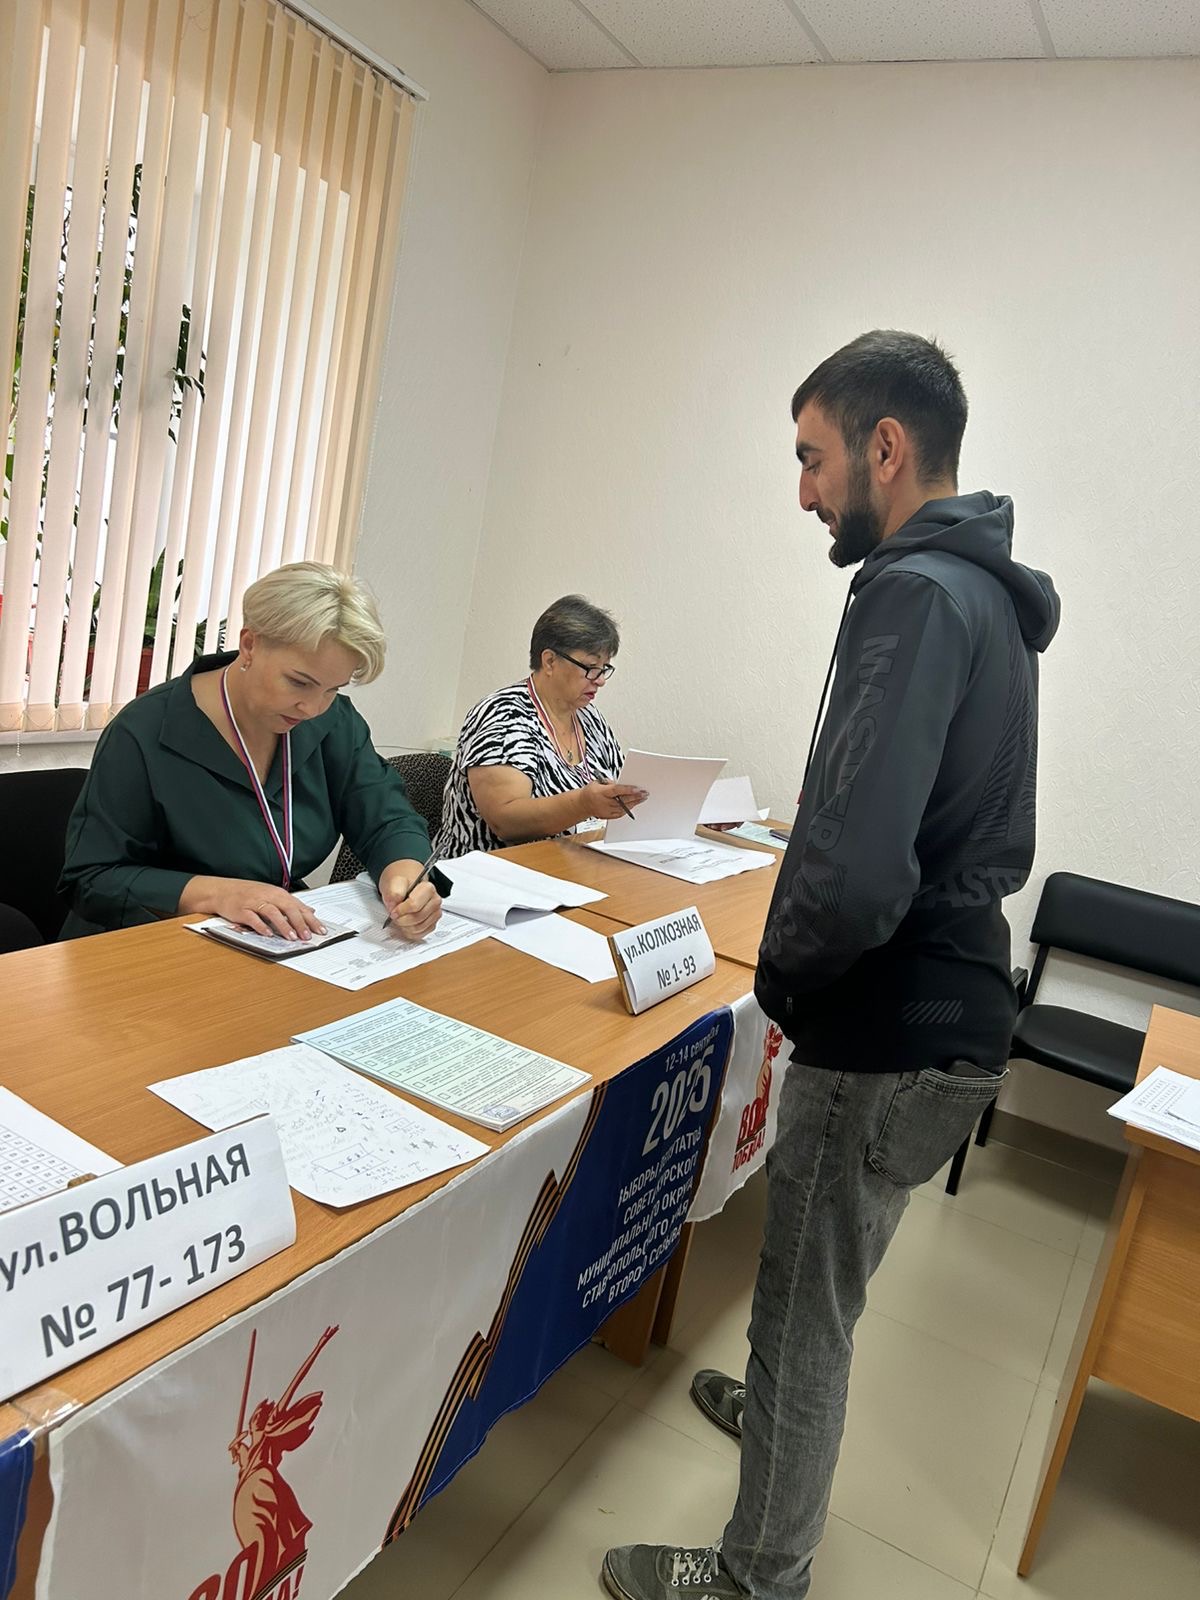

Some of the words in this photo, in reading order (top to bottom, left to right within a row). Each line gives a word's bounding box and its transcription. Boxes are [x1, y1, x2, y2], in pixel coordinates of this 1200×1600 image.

[623, 913, 702, 963] ул.КОЛХОЗНАЯ
[656, 968, 672, 989] №
[683, 955, 697, 977] 93
[665, 1045, 689, 1073] 12-14
[641, 1044, 715, 1157] 2025
[0, 1143, 251, 1292] ул.ВОЛЬНАЯ
[623, 1186, 658, 1225] СОВЕТ
[40, 1303, 97, 1358] №
[183, 1224, 246, 1286] 173
